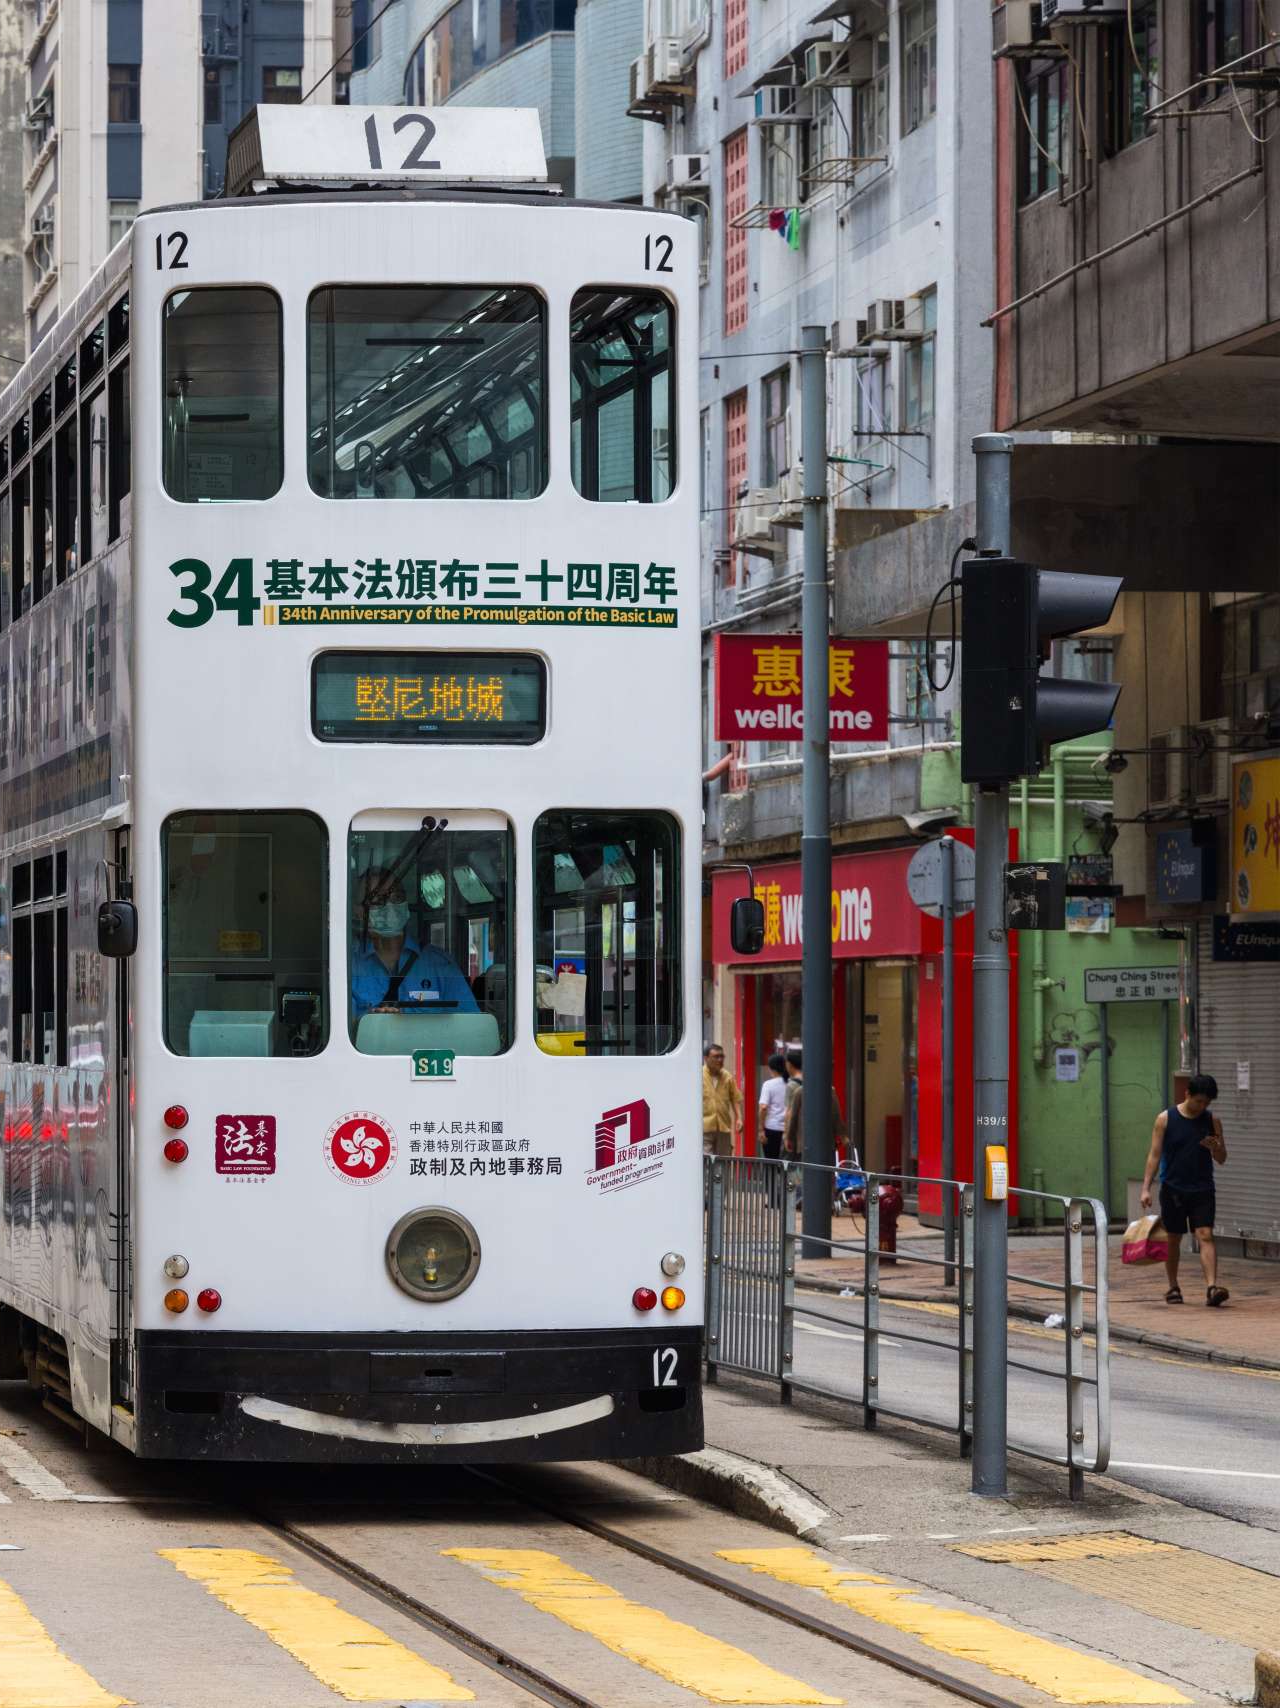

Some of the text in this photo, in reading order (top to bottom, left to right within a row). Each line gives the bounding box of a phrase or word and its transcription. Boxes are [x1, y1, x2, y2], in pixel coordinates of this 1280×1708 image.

[365, 113, 441, 171] 12
[156, 231, 189, 270] 12
[645, 233, 674, 273] 12
[167, 558, 261, 628] 34
[264, 558, 678, 604] 基本法頒布三十四周年
[282, 606, 675, 625] 34th Anniversary of the Promulgation of the Basic Law
[355, 676, 504, 721] 堅尼地城
[734, 704, 873, 730] wellcme
[1088, 973, 1118, 983] Chung
[1120, 971, 1147, 982] Ching
[419, 1057, 453, 1077] S19
[410, 1120, 504, 1135] 中華人民共和國
[410, 1138, 531, 1153] 香港特別行政區政府
[617, 1136, 675, 1164] 政府資助計劃
[338, 1172, 385, 1185] HONG KONG
[586, 1163, 638, 1186] Government-
[600, 1161, 664, 1190] funded programme
[652, 1347, 678, 1387] 12
